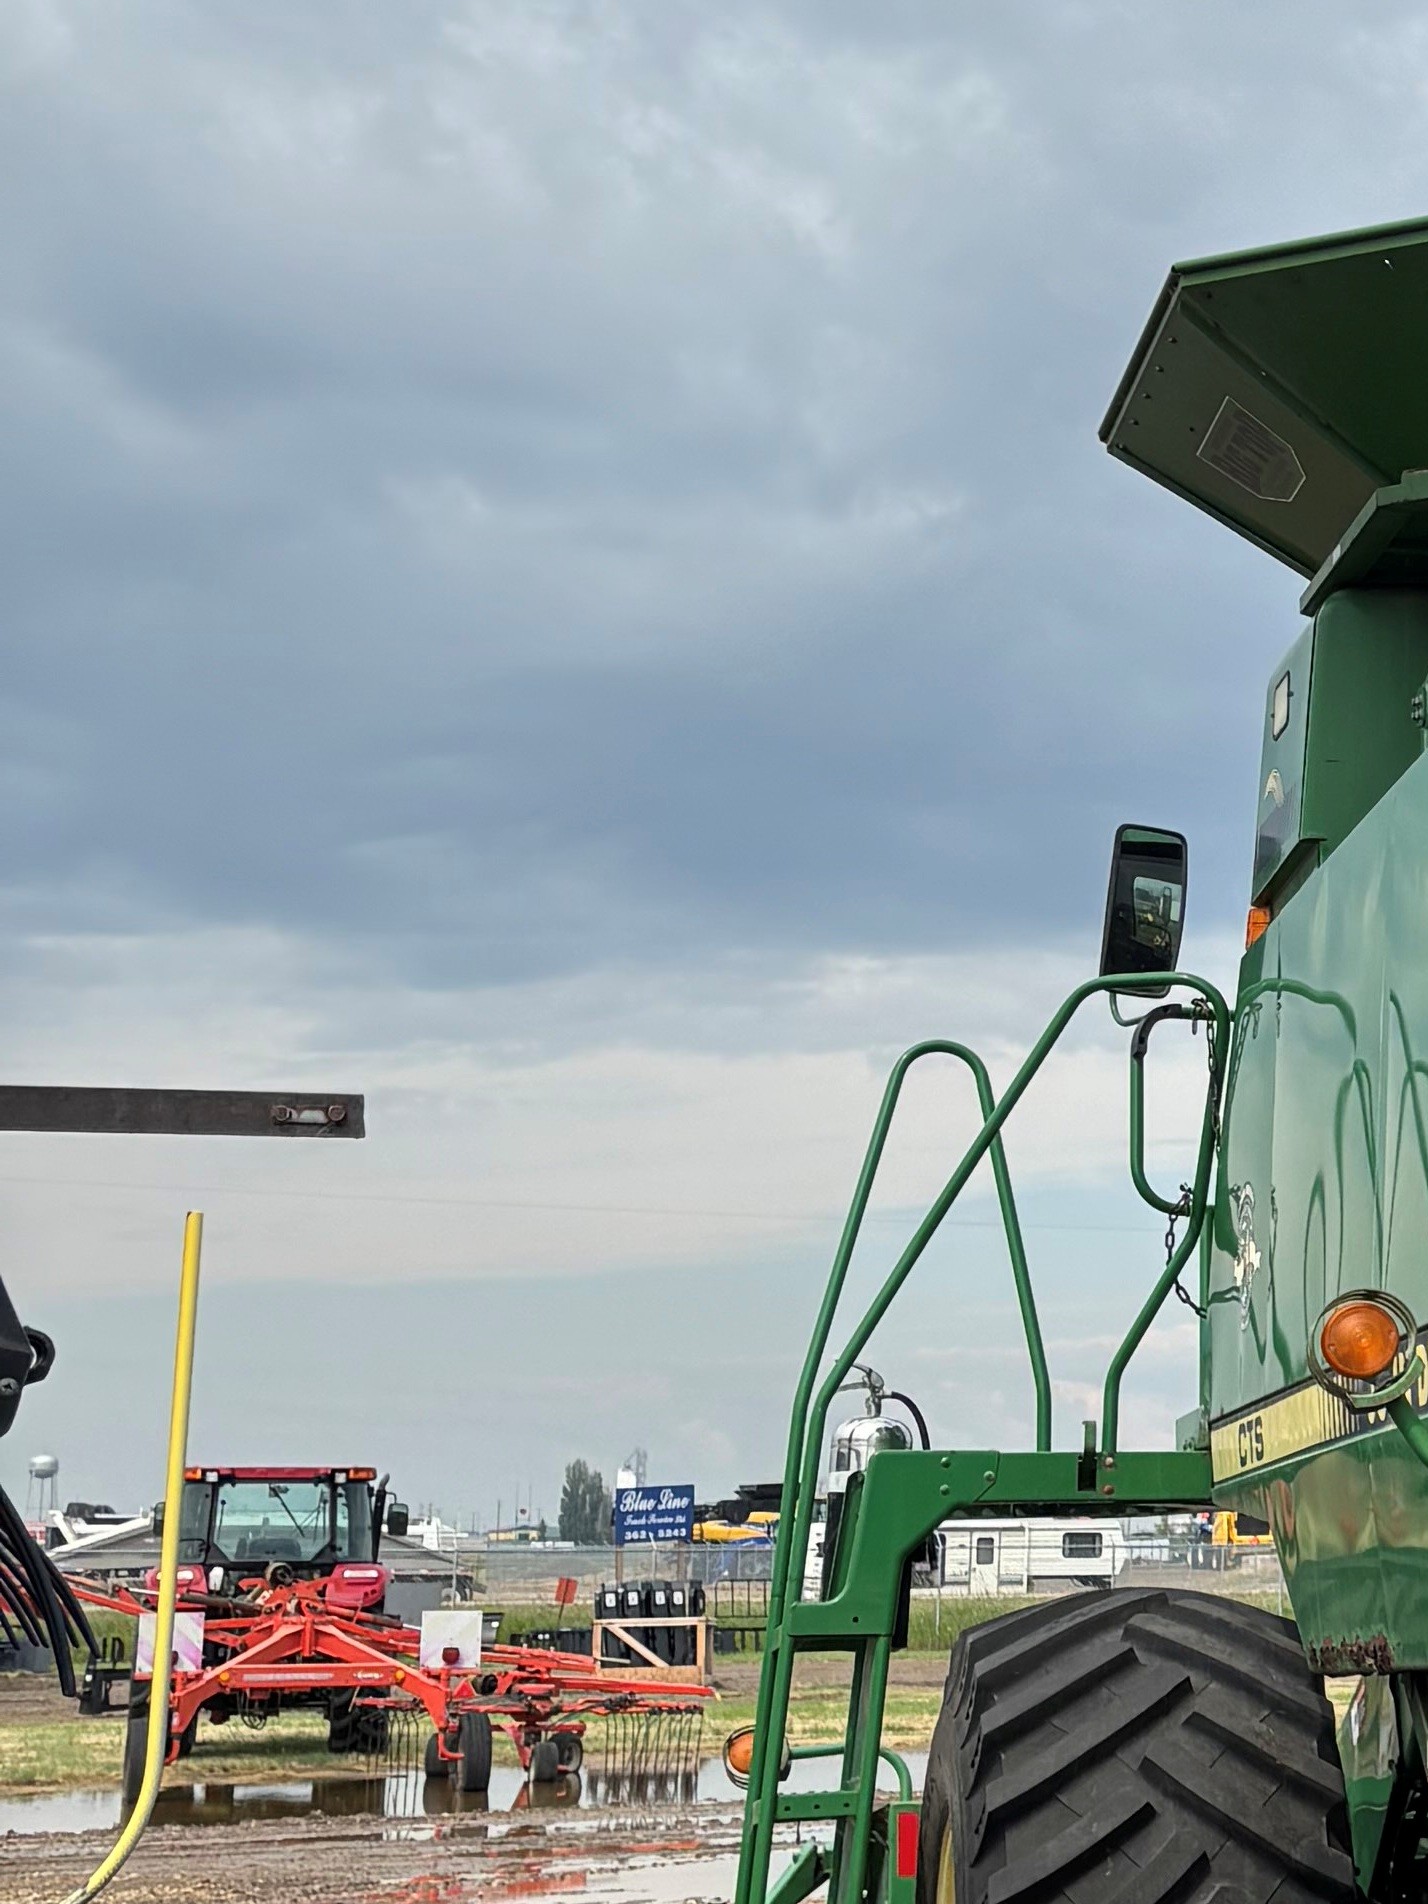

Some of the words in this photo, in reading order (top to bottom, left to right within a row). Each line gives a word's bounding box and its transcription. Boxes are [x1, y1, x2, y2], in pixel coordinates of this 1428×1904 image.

[1238, 1416, 1264, 1467] CTS
[620, 1490, 657, 1512] Blue
[657, 1488, 690, 1510] Line
